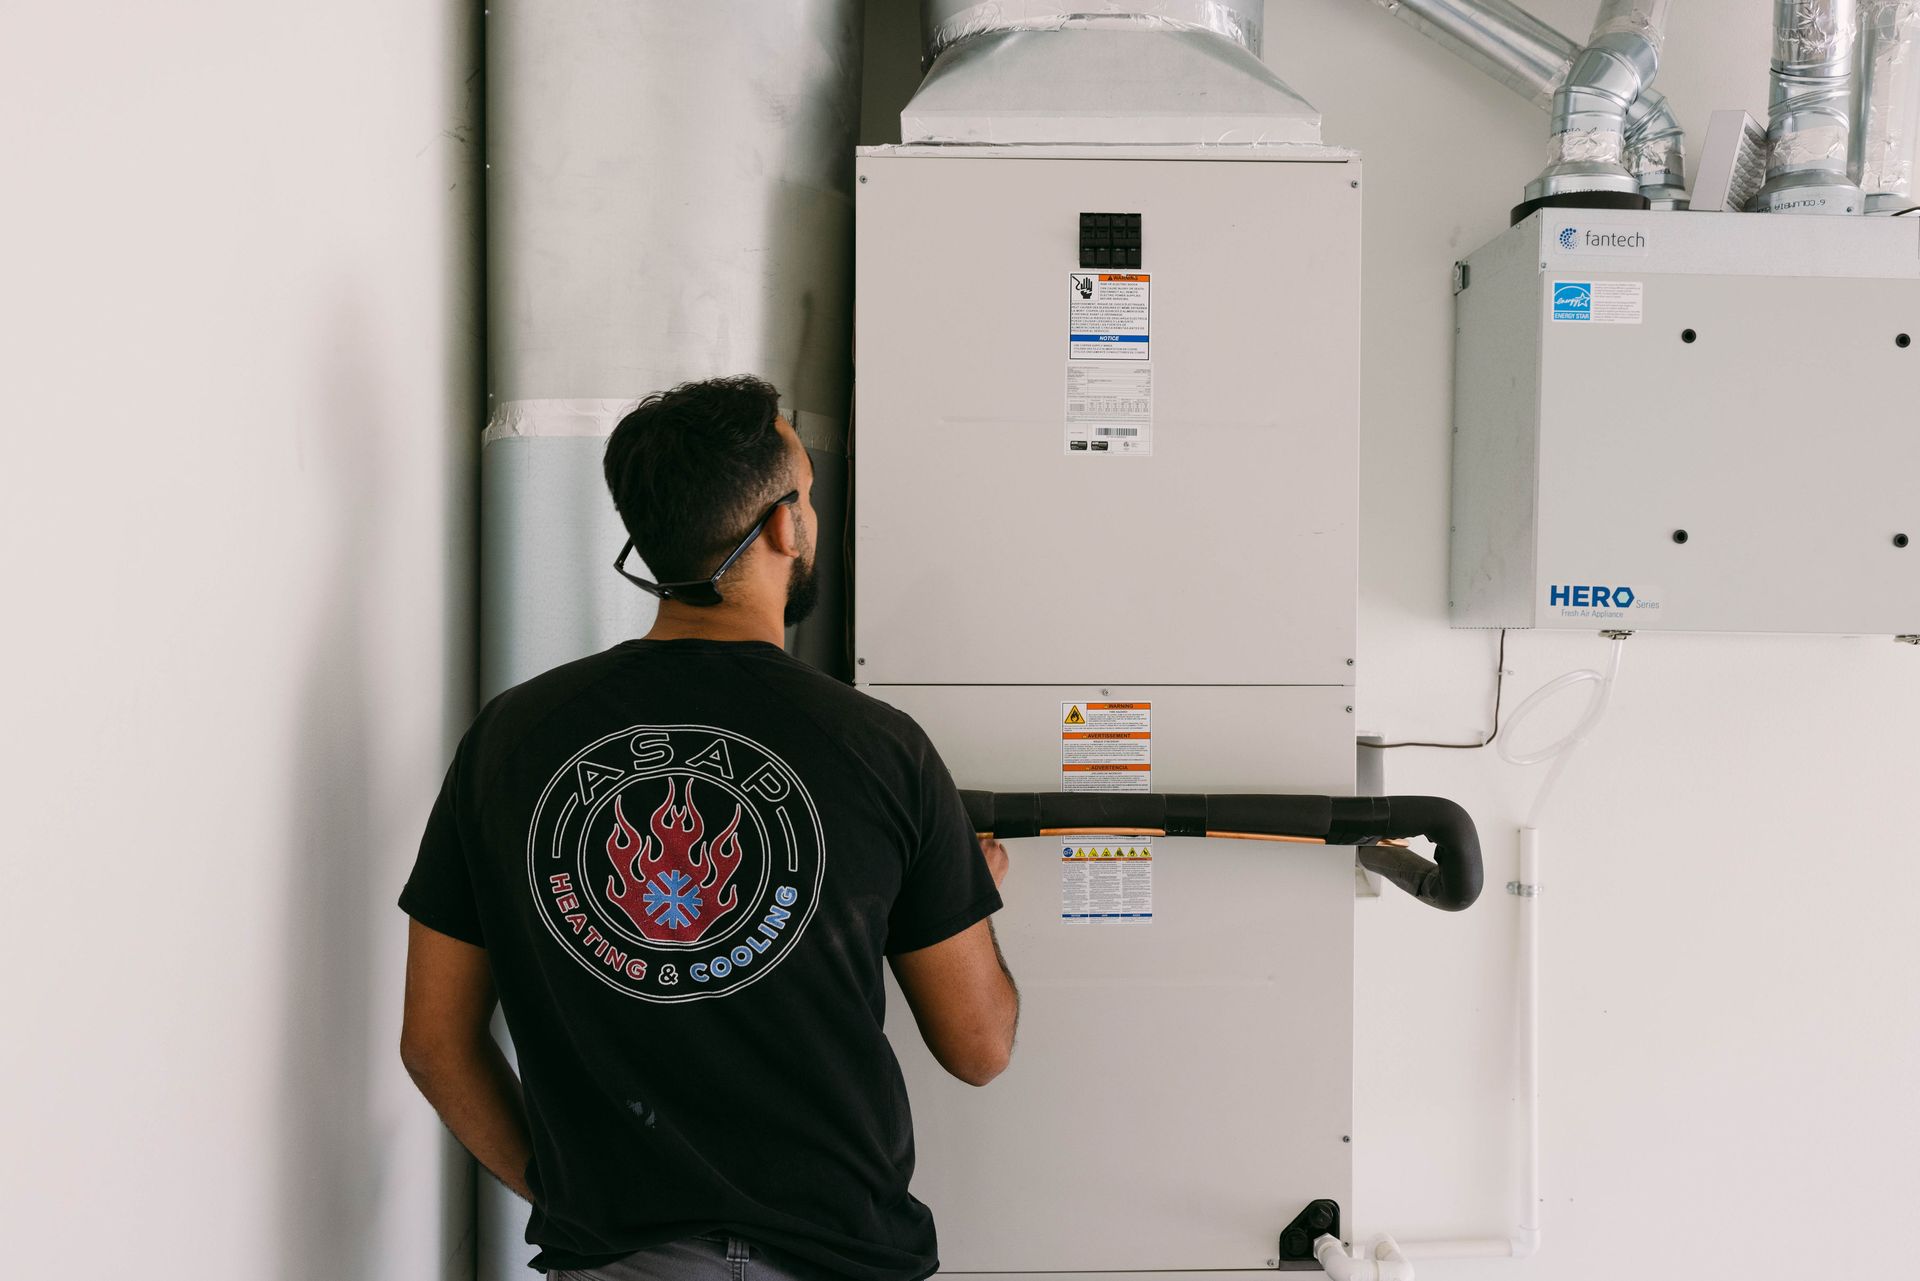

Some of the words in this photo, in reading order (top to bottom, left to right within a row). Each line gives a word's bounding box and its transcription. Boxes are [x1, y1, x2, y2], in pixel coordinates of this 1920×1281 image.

[1585, 230, 1645, 247] fantech
[1550, 585, 1635, 608] HERO
[1636, 600, 1660, 609] Series
[1561, 609, 1579, 617] Fresh
[1591, 610, 1624, 618] Appliance
[577, 732, 790, 806] ASAP
[550, 873, 647, 980] HEATING
[658, 964, 679, 985] &
[689, 886, 798, 983] COOLING
